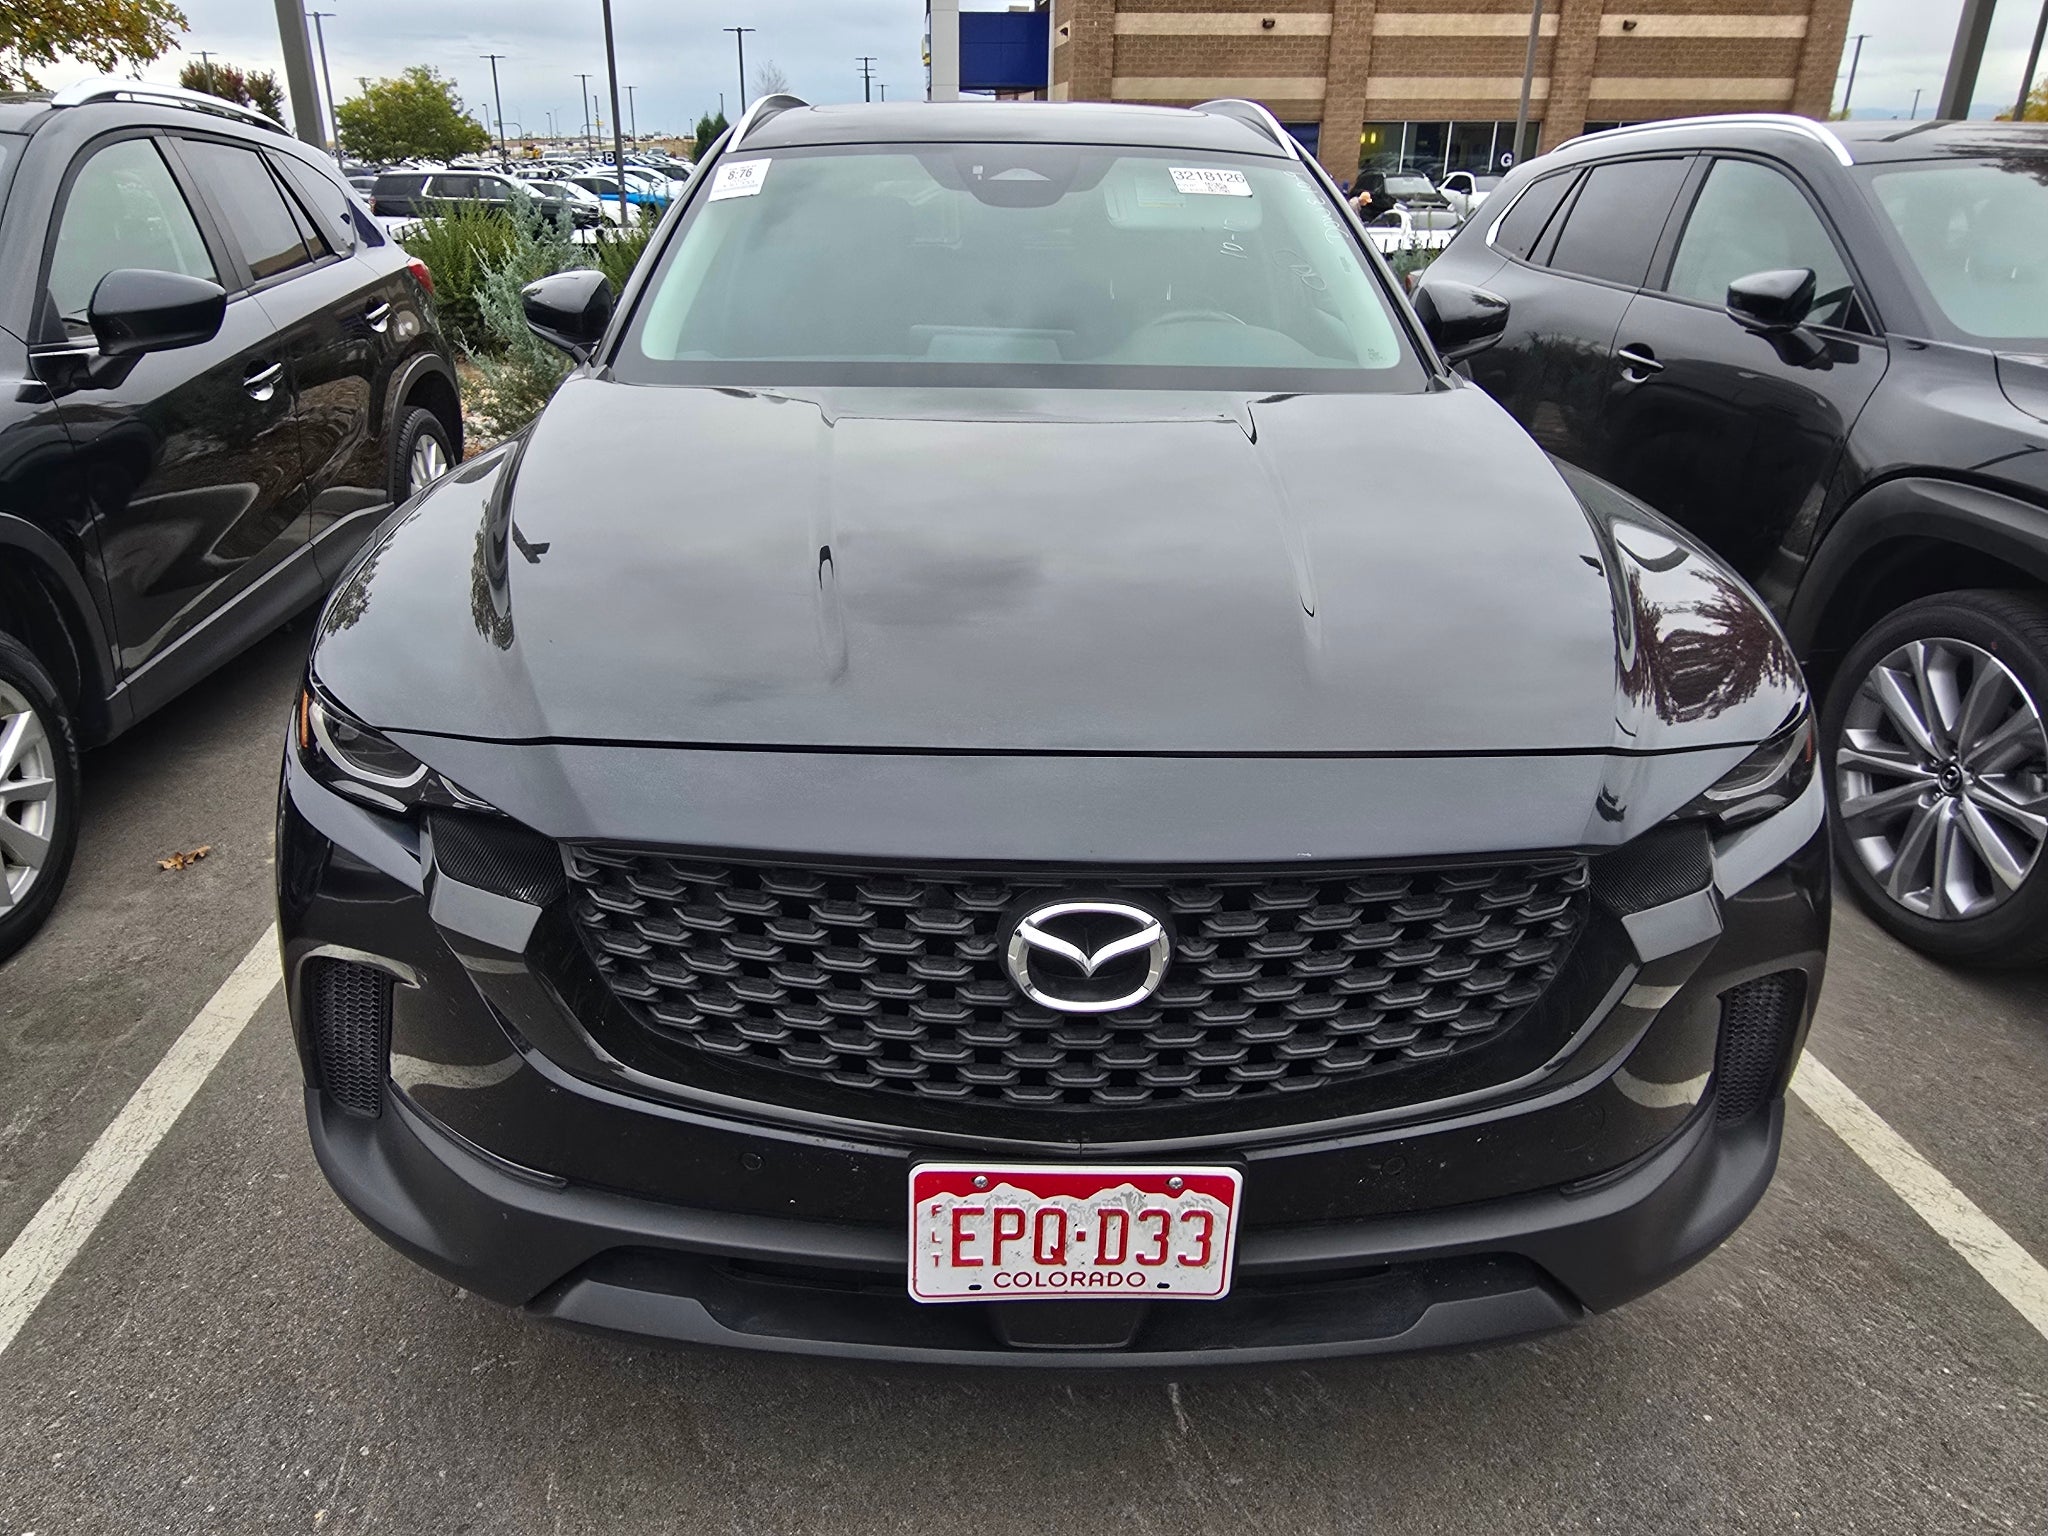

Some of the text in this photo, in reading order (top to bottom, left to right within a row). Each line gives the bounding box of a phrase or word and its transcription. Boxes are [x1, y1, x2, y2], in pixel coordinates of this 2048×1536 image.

[604, 152, 615, 164] B
[1500, 153, 1513, 167] G
[1173, 170, 1245, 184] 3218126
[993, 1271, 1146, 1288] COLORADO
